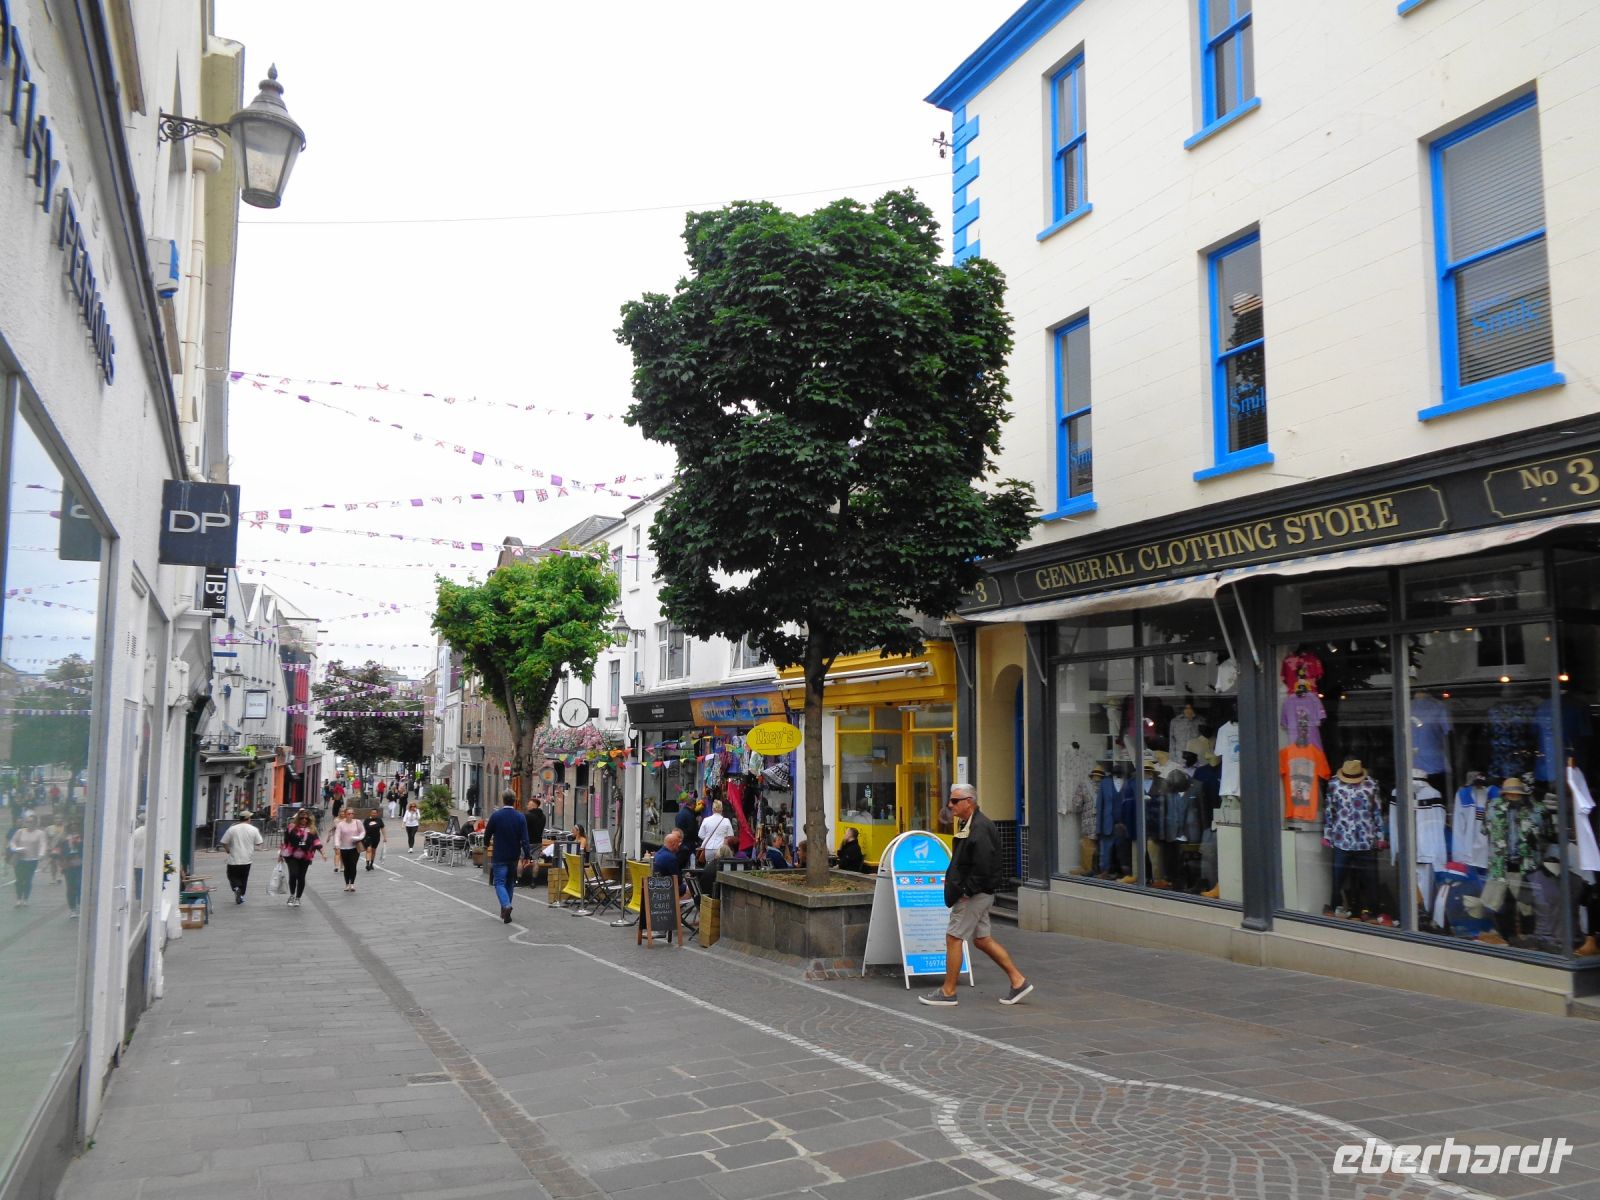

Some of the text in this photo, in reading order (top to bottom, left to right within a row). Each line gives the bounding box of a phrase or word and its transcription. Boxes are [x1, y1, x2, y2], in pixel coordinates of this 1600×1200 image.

[58, 188, 115, 386] PERKINS
[1520, 458, 1599, 495] No 3
[168, 509, 231, 534] DP
[1035, 498, 1399, 590] GENERAL CLOTHING STORE
[205, 567, 229, 594] IB
[975, 582, 988, 602] 3
[756, 727, 794, 748] Ikey's
